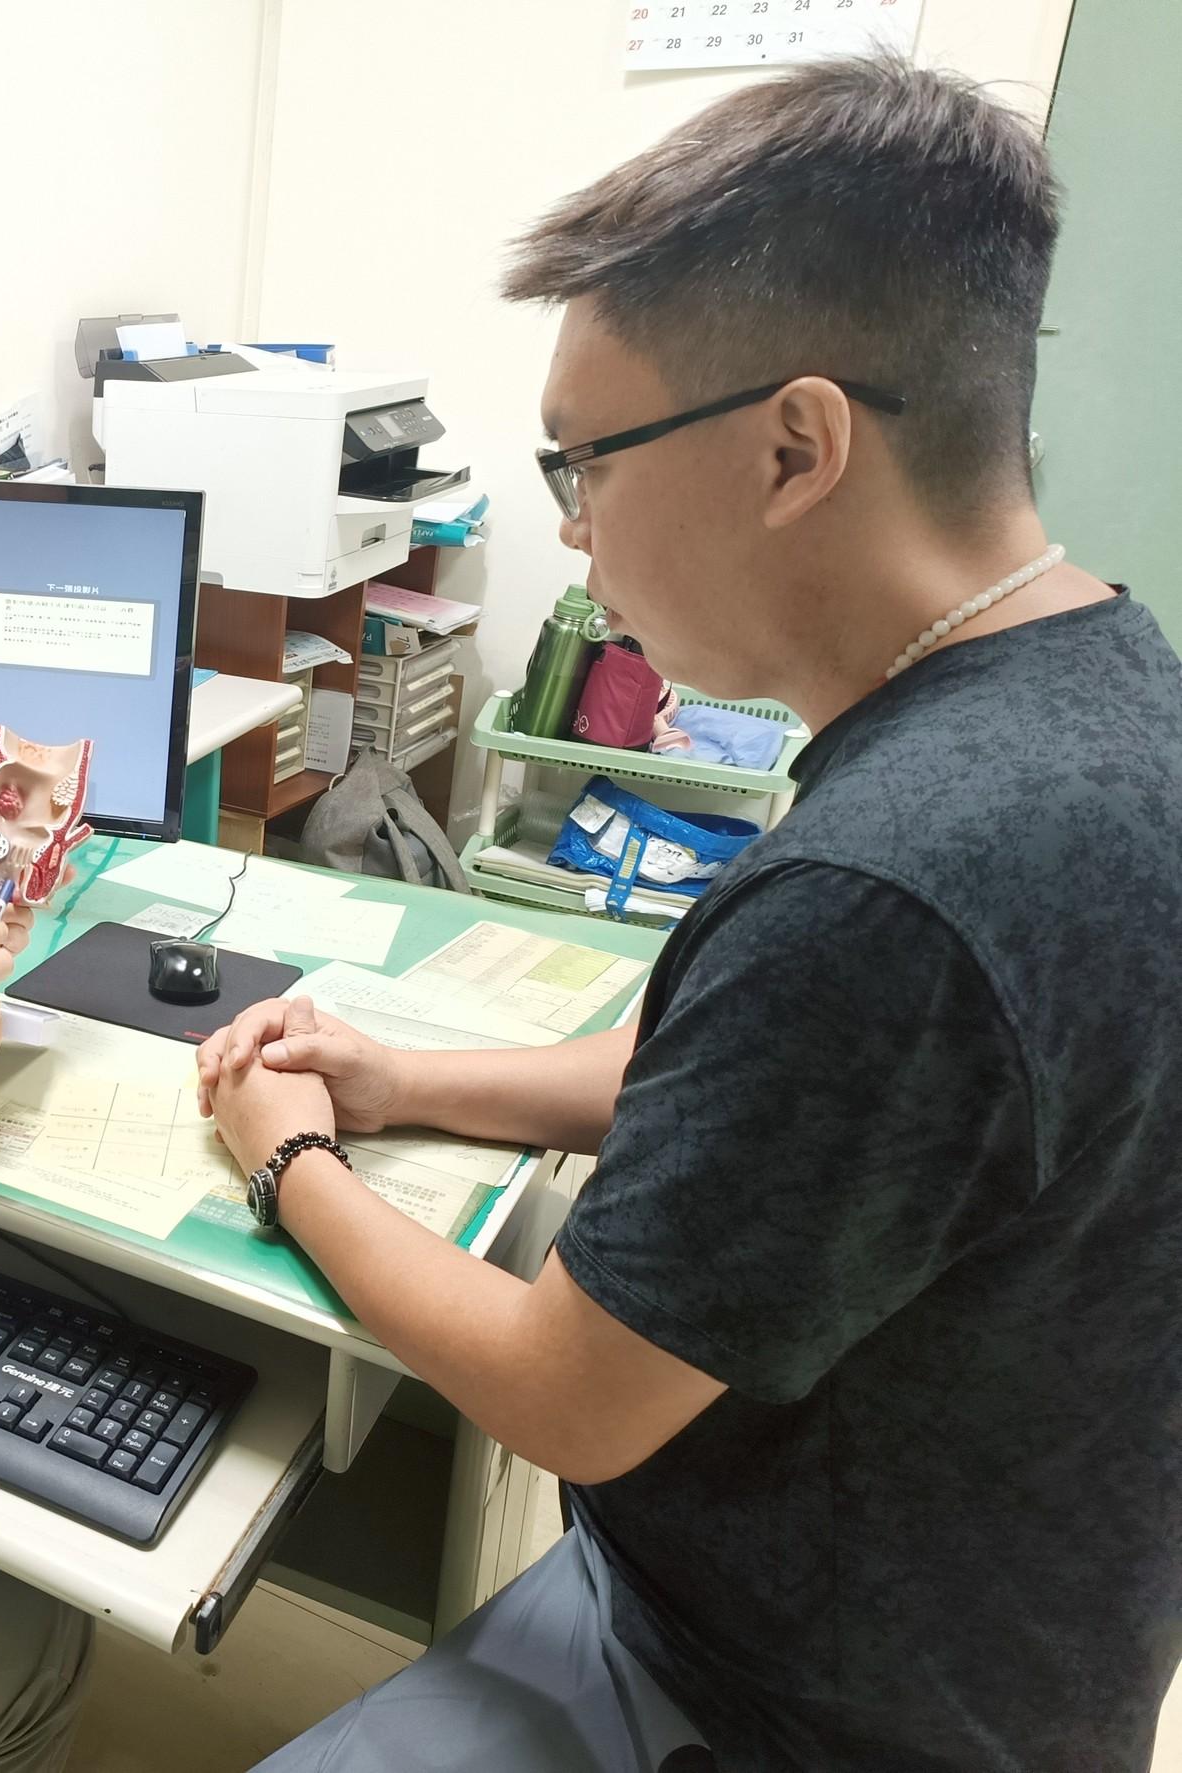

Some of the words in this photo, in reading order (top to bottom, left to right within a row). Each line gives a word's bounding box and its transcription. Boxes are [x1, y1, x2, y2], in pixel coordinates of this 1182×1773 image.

[633, 8, 649, 19] 20
[671, 7, 686, 18] 21
[712, 4, 728, 16] 22
[753, 2, 769, 13] 23
[795, 0, 811, 11] 24
[837, 0, 854, 8] 25
[628, 40, 644, 51] 27
[666, 38, 682, 49] 28
[706, 36, 722, 48] 29
[747, 34, 763, 46] 30
[788, 32, 804, 43] 31
[98, 1379, 115, 1388] Home
[125, 1438, 142, 1448] PgDn
[112, 1459, 124, 1468] Del
[150, 1456, 167, 1467] Enter
